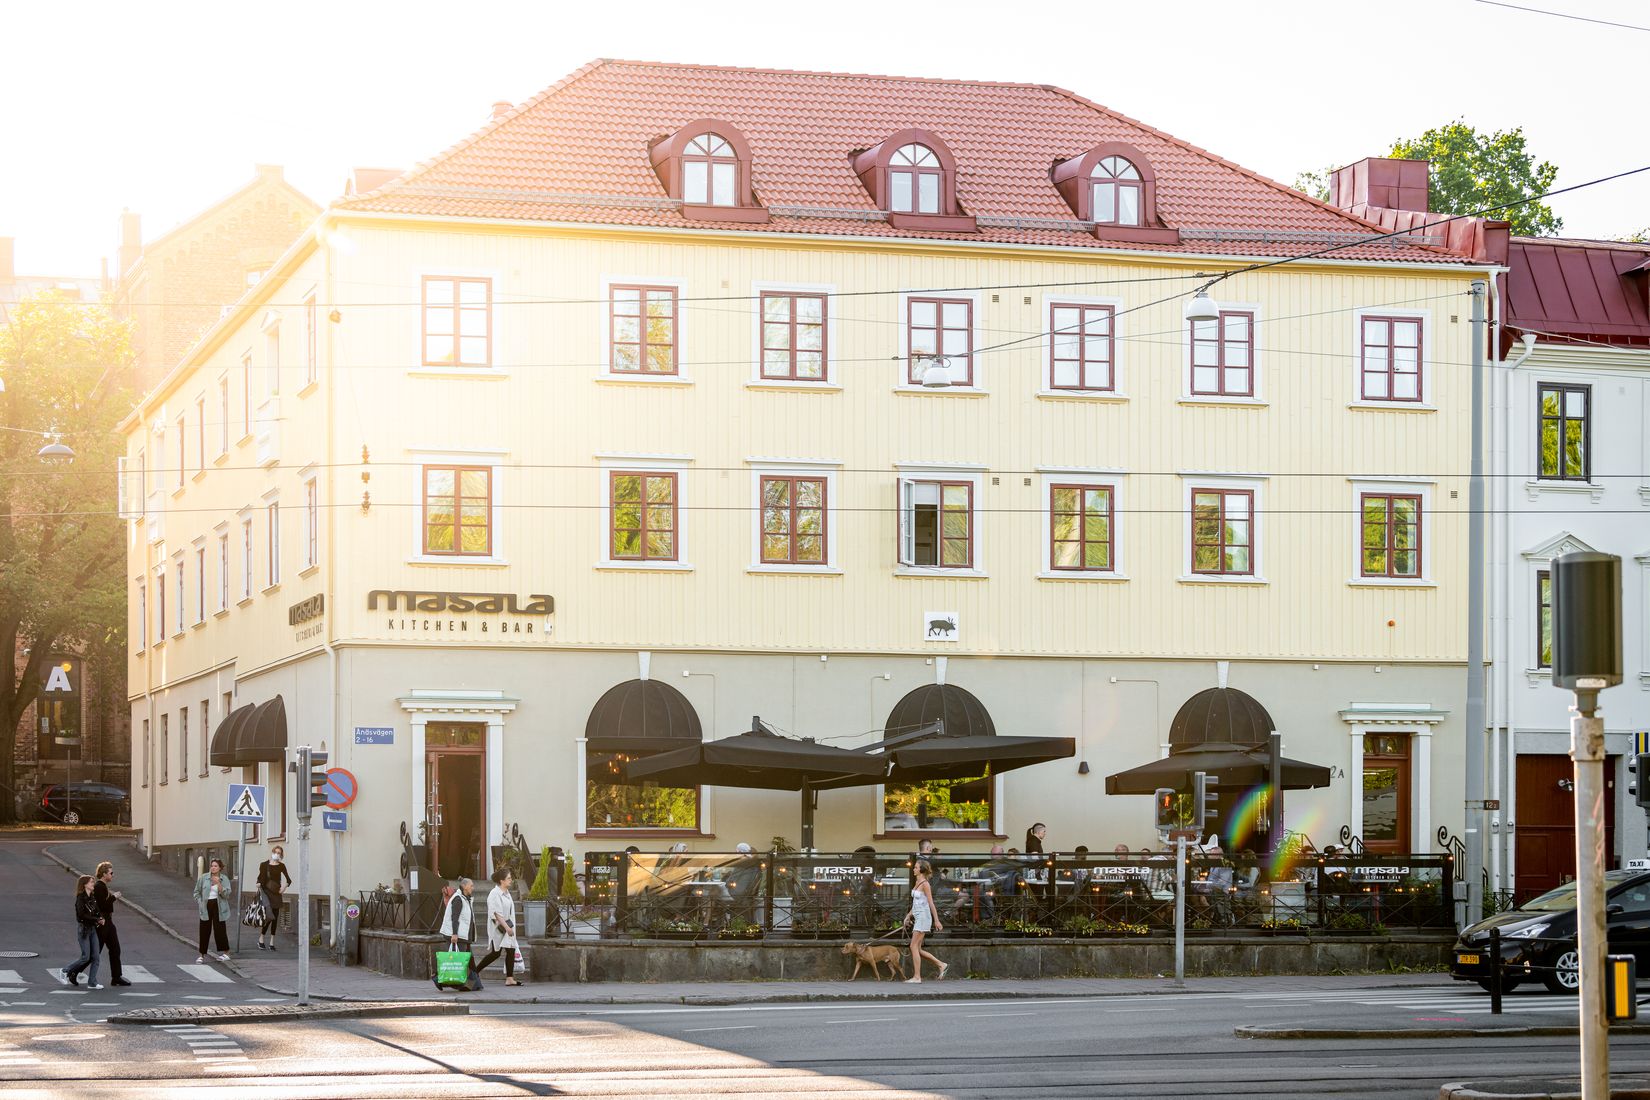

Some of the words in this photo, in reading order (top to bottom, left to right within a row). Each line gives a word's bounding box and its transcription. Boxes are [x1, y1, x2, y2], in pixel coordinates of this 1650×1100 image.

[389, 619, 467, 631] KITCHEN
[482, 622, 488, 632] &
[502, 622, 533, 633] BAR
